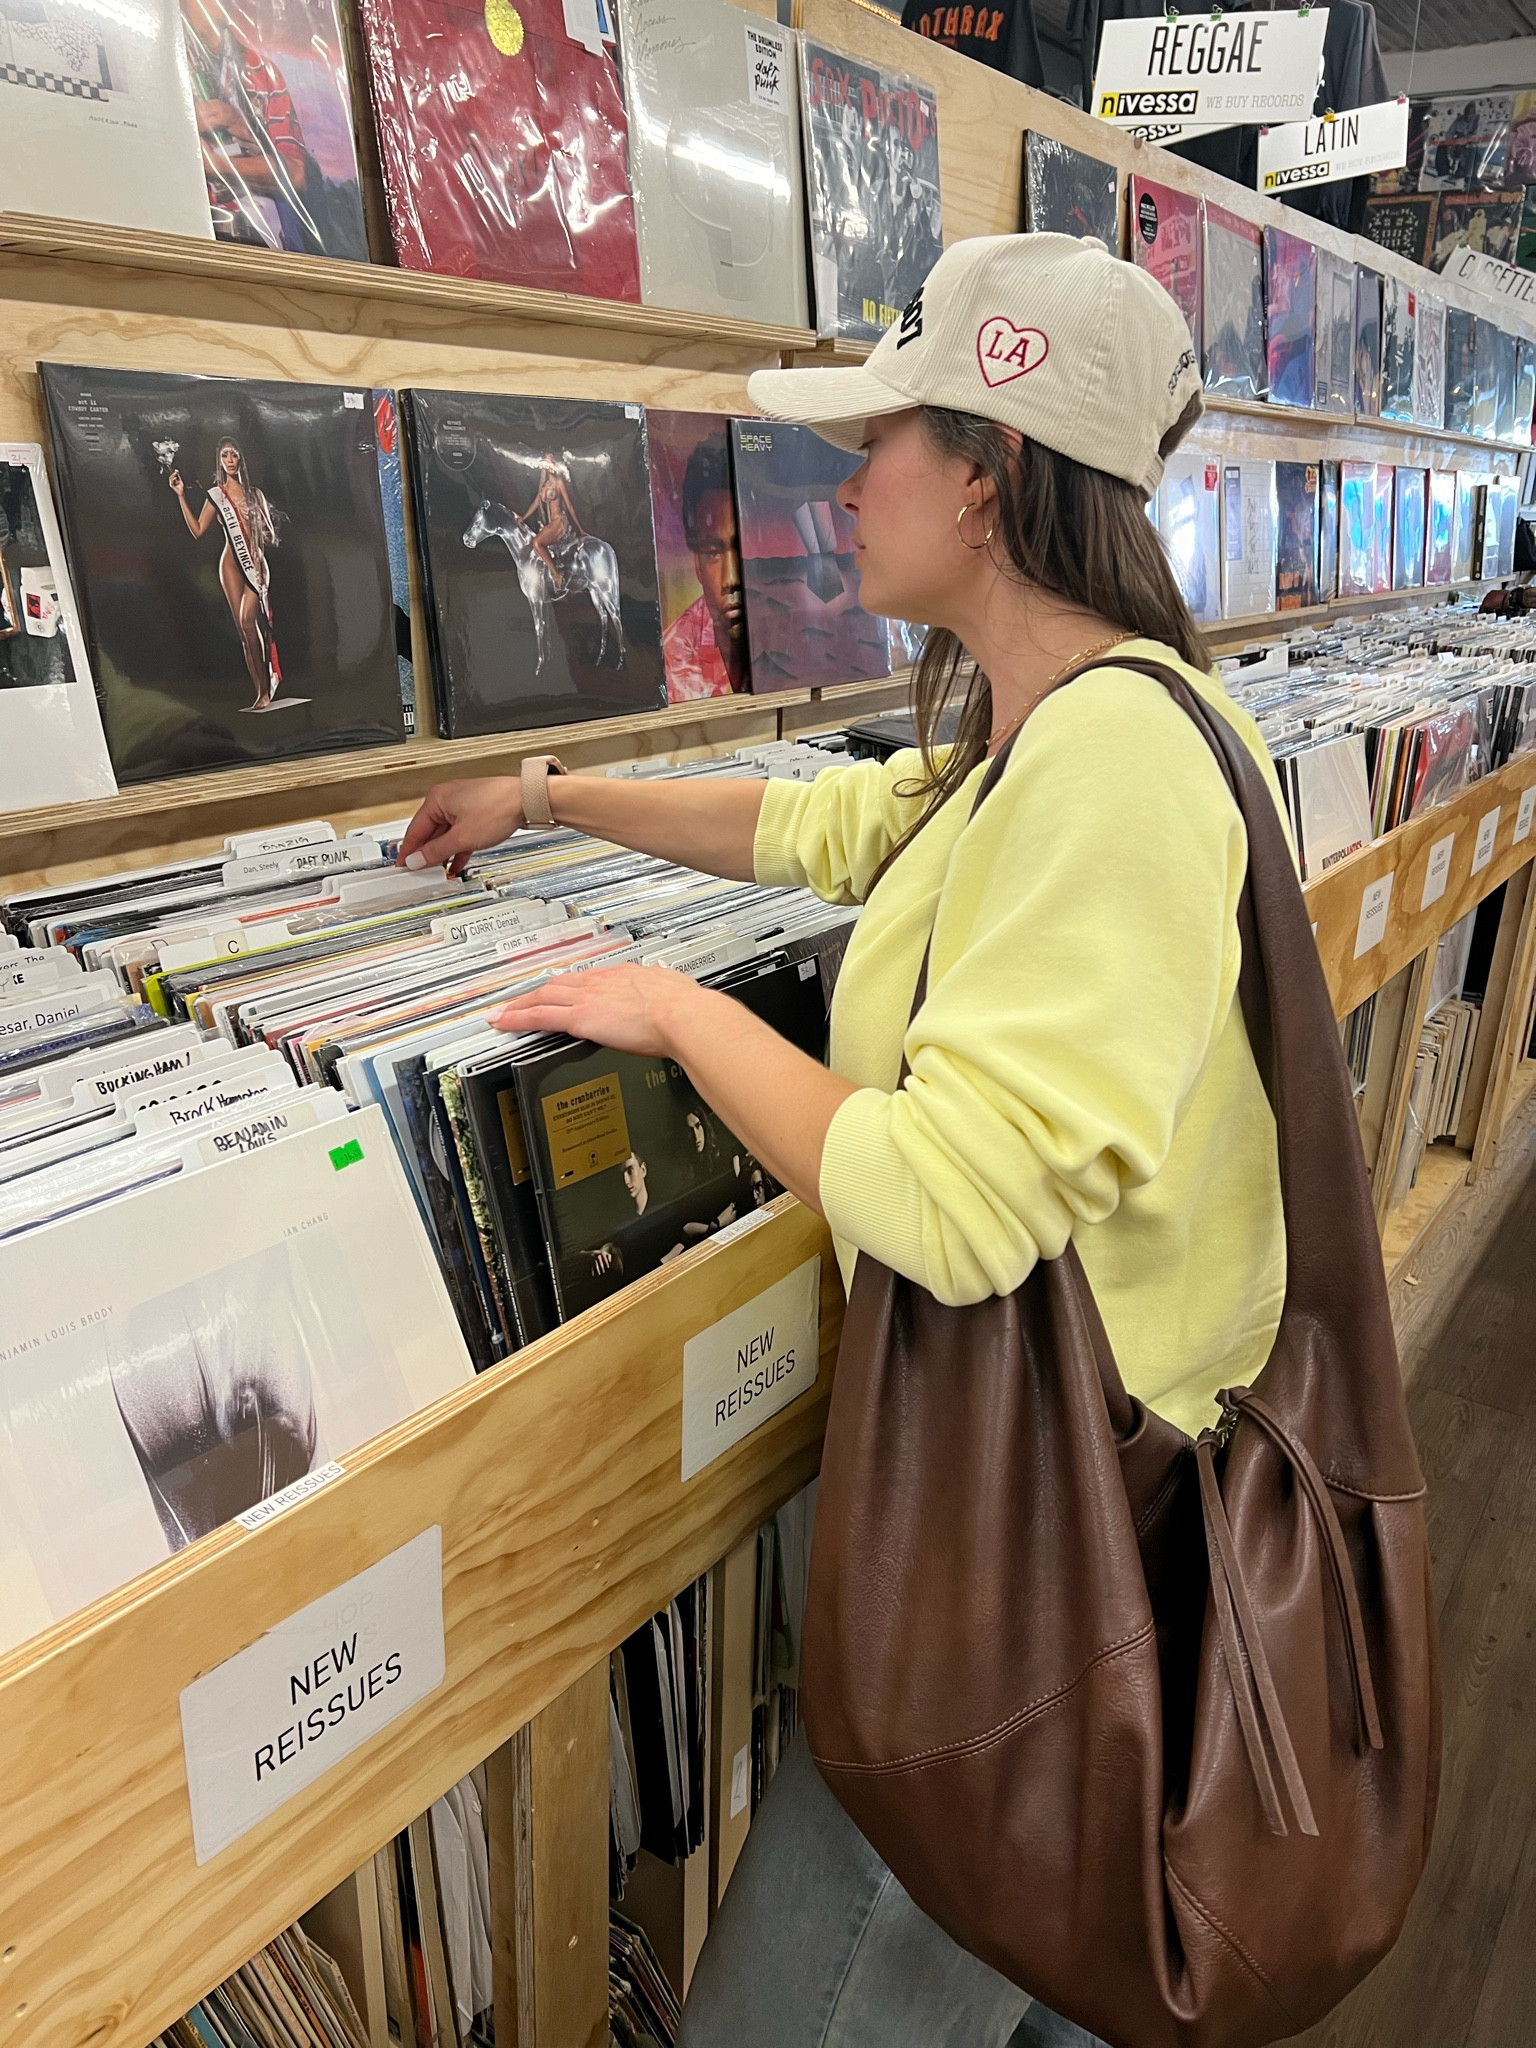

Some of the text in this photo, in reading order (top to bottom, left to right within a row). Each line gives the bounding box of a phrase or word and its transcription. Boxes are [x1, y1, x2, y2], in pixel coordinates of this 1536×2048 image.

[912, 4, 1004, 41] NTHRAX
[747, 30, 783, 52] THE DRUMLESS
[755, 44, 777, 59] EDITION
[1147, 20, 1269, 76] REGGAE
[755, 60, 780, 79] daft
[754, 73, 780, 95] punk
[1100, 91, 1198, 114] nivessa
[1205, 94, 1305, 109] WE BUY RECORDS
[1304, 114, 1360, 156] LATIN
[1264, 163, 1329, 189] nivessa
[862, 297, 876, 324] NO
[985, 330, 1030, 369] LA
[740, 434, 772, 444] SPACE
[740, 443, 773, 452] HEAVY
[222, 506, 236, 521] act
[243, 860, 279, 875] Dan, Steely
[296, 850, 352, 869] DAFT PUNK
[497, 914, 521, 930] Denzel
[227, 940, 240, 954] C
[35, 1003, 80, 1027] Daniel
[645, 1069, 667, 1089] the
[556, 1086, 610, 1111] the cranberries
[238, 1132, 278, 1154] LOUIS
[282, 1211, 330, 1238] IAN CHANG
[44, 1321, 77, 1343] LOUIS
[80, 1304, 114, 1328] BRODY
[736, 1326, 775, 1374] NEW
[714, 1348, 797, 1427] REISSUES
[241, 1464, 342, 1526] NEW REISSUES
[289, 1632, 361, 1706] NEW
[252, 1652, 403, 1783] REISSUES
